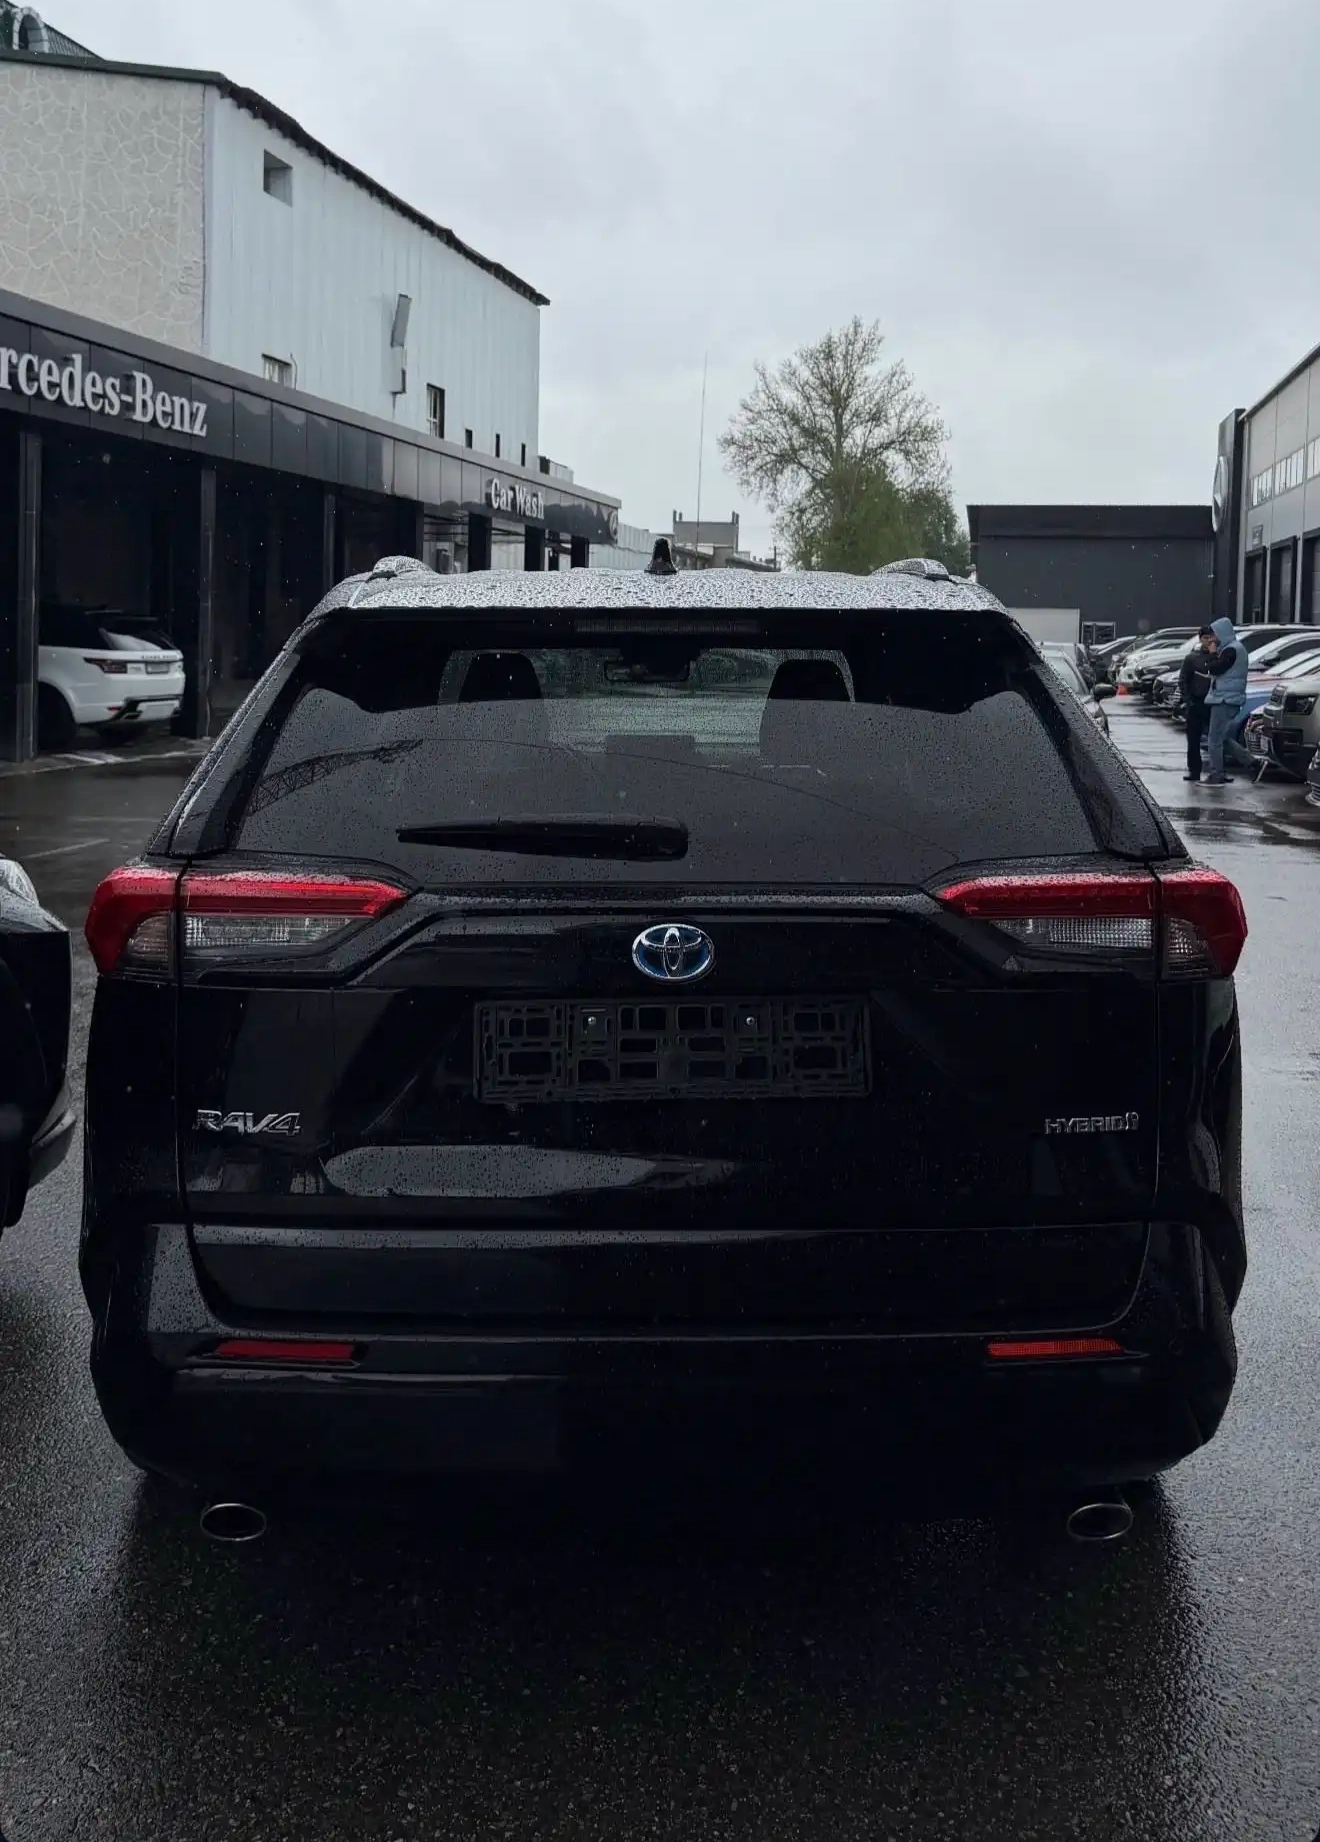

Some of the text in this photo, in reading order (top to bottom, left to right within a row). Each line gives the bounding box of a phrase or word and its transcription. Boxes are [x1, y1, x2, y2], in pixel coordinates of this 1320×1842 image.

[0, 346, 208, 437] rcedes-Benz
[491, 477, 545, 520] Car Wash
[192, 1109, 301, 1136] RAV4
[1044, 1115, 1124, 1134] HYBRID
